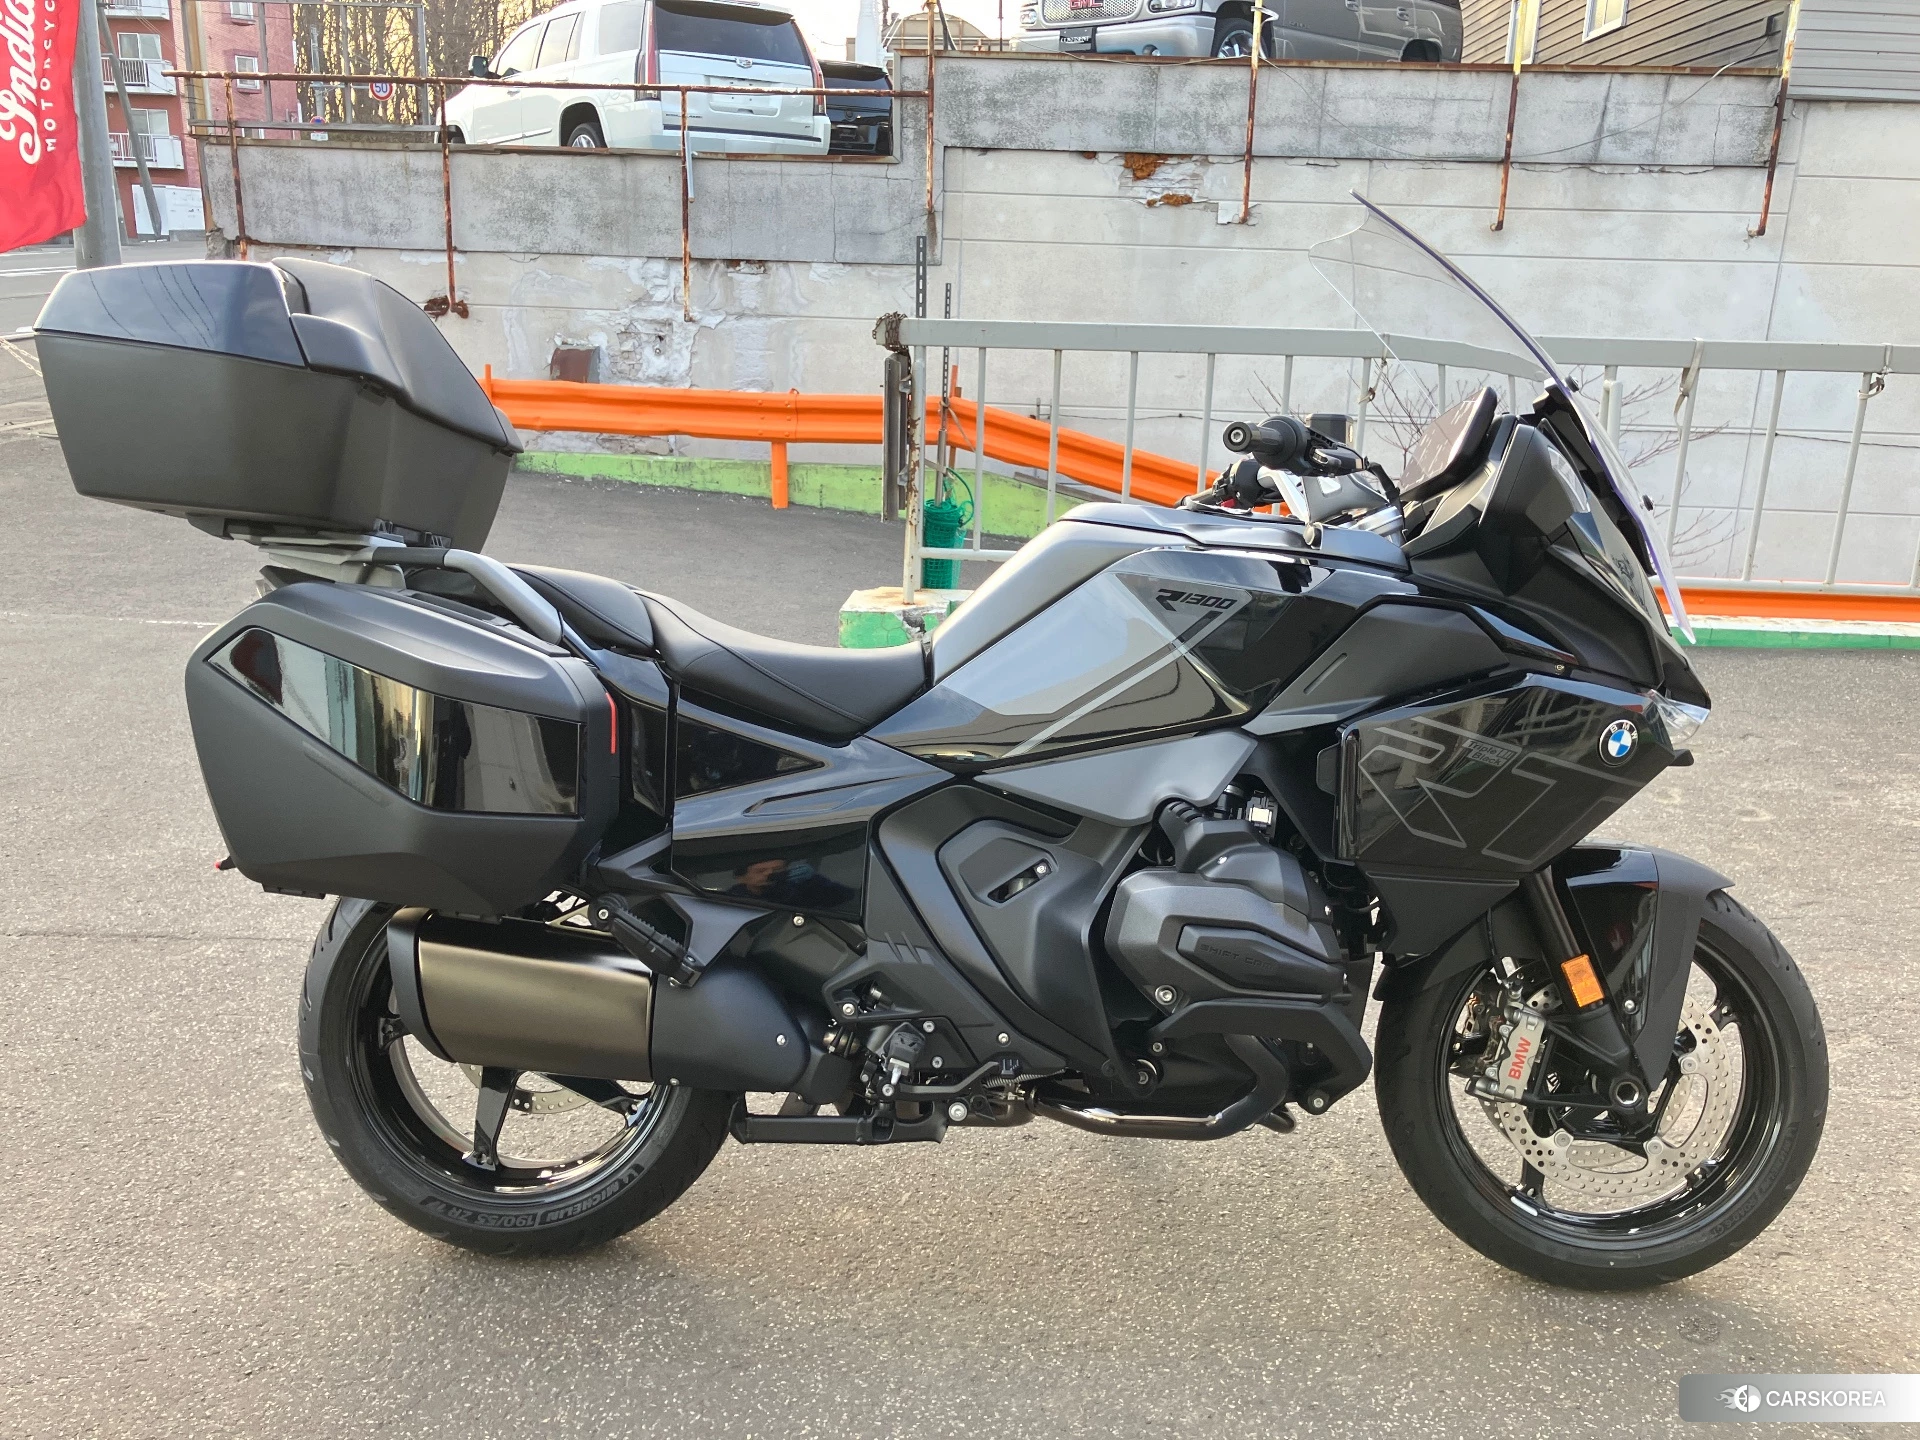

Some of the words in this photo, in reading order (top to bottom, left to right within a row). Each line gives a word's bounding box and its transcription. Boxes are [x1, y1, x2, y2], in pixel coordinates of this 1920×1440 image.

[1609, 721, 1638, 740] BMW
[1468, 740, 1497, 755] Triple
[1472, 751, 1502, 766] Black
[1200, 943, 1240, 960] SHIFT
[1508, 1037, 1532, 1079] BMW
[546, 1182, 619, 1222] MICHELIN
[448, 1206, 473, 1221] ZR
[477, 1212, 534, 1227] 190/55
